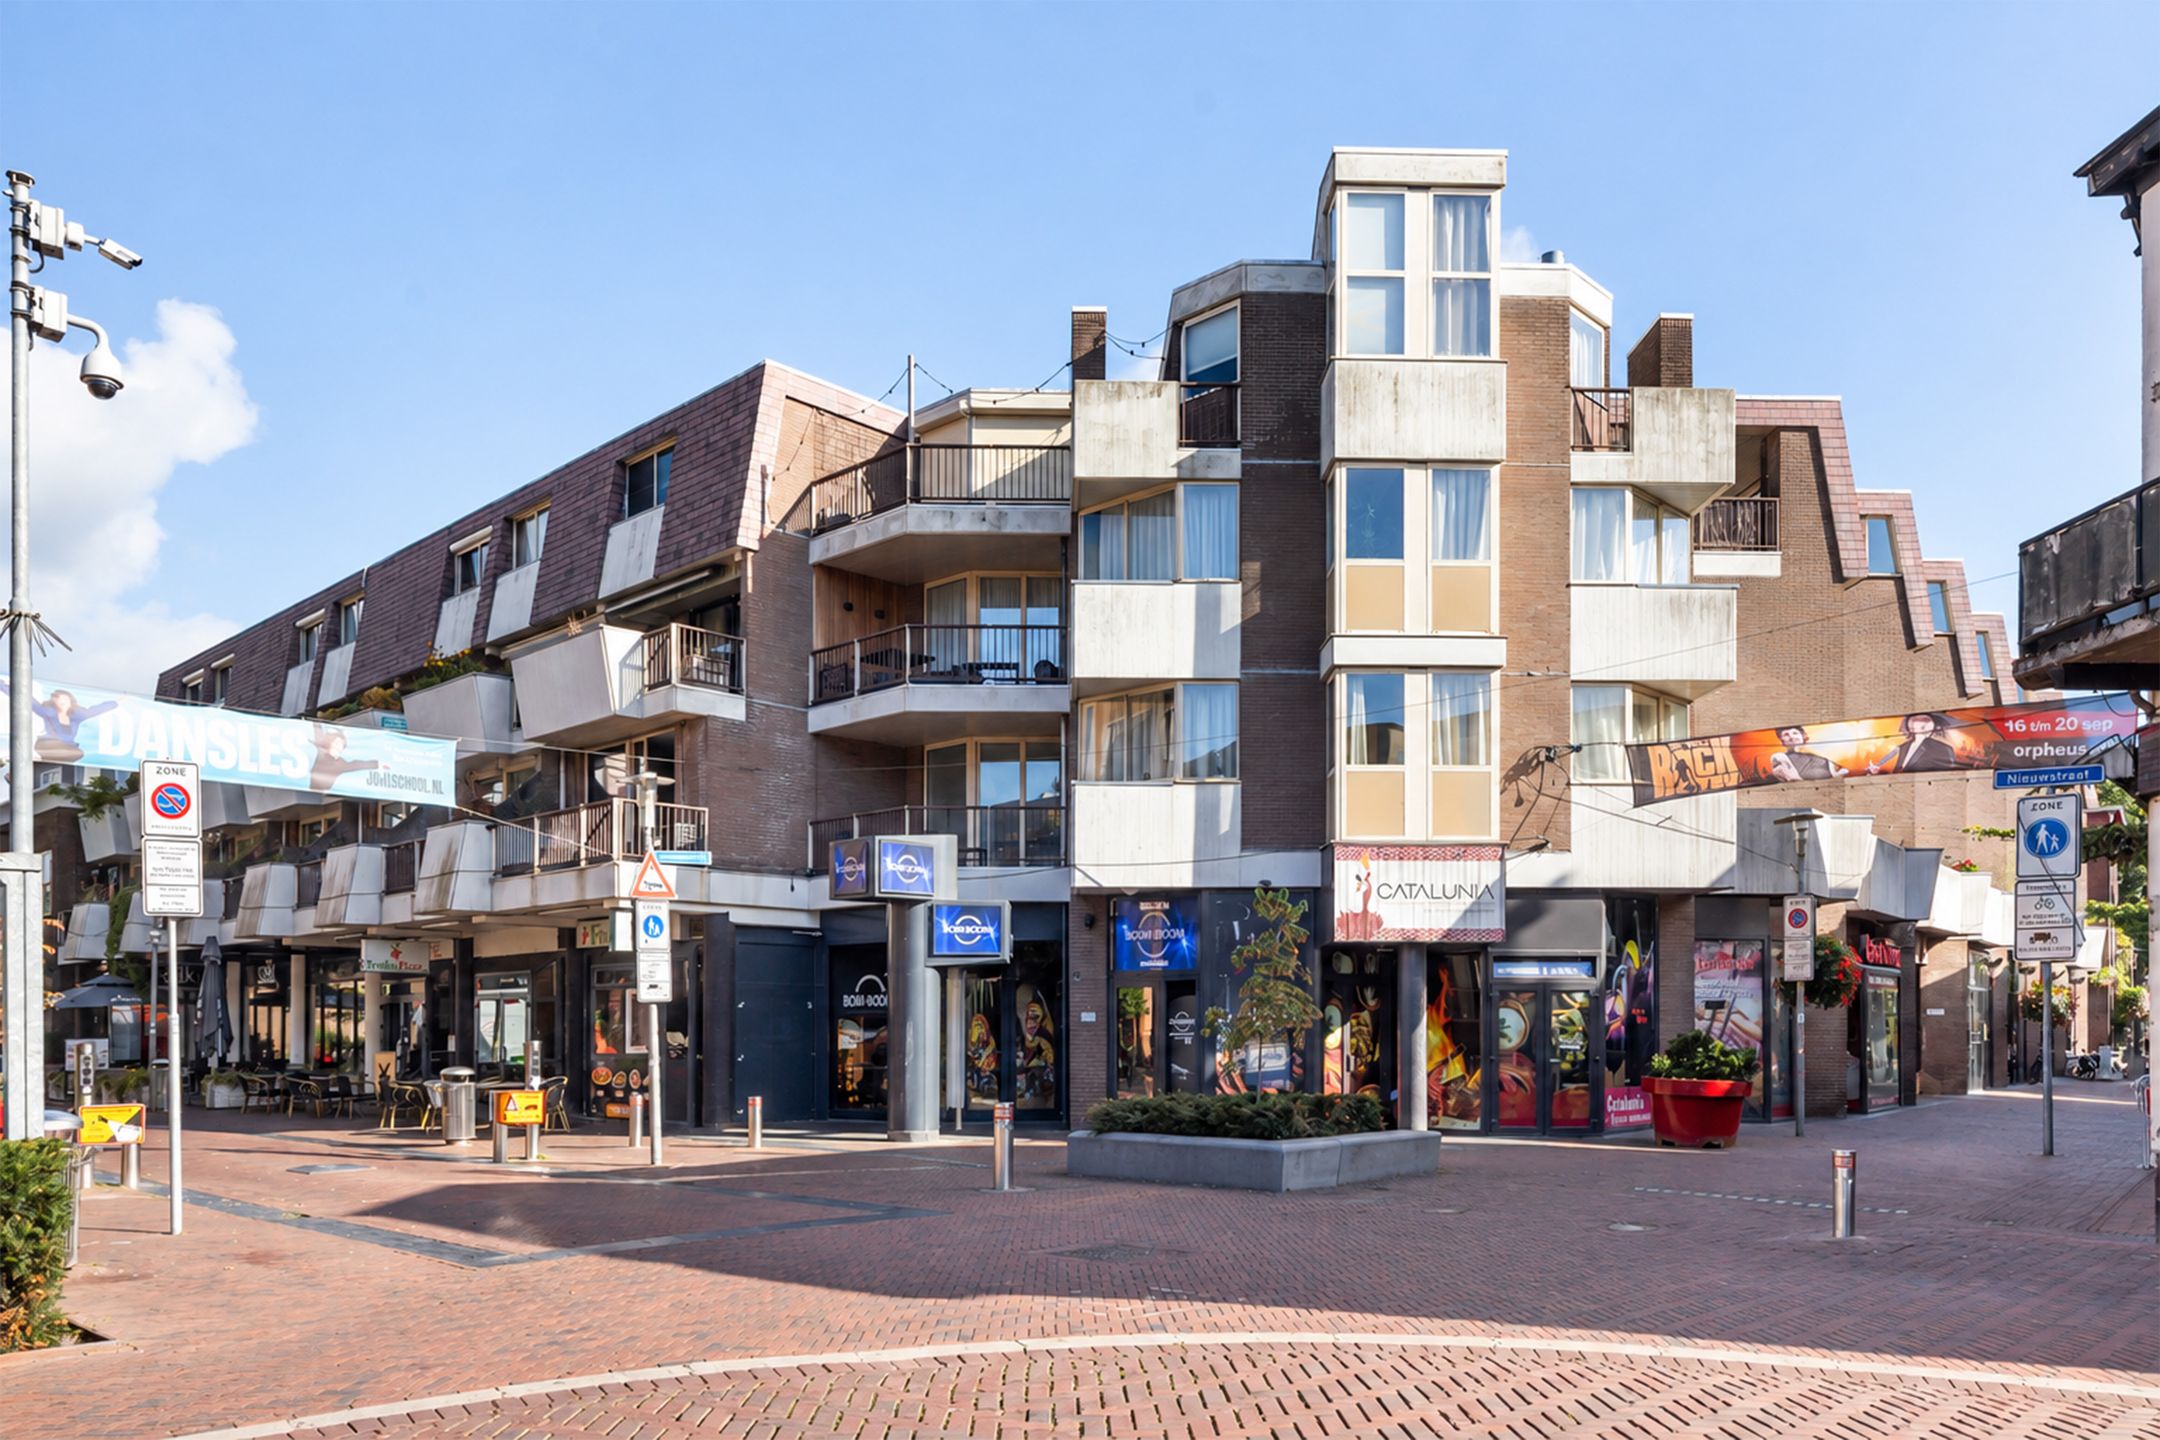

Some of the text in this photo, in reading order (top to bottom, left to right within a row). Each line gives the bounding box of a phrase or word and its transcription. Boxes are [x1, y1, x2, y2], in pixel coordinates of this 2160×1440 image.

[2004, 716, 2113, 733] 16 t/m 20 sep
[98, 704, 312, 780] DANSLES
[2013, 742, 2087, 760] orpheus
[156, 766, 186, 777] ZONE
[1377, 882, 1494, 899] CATALUNIA
